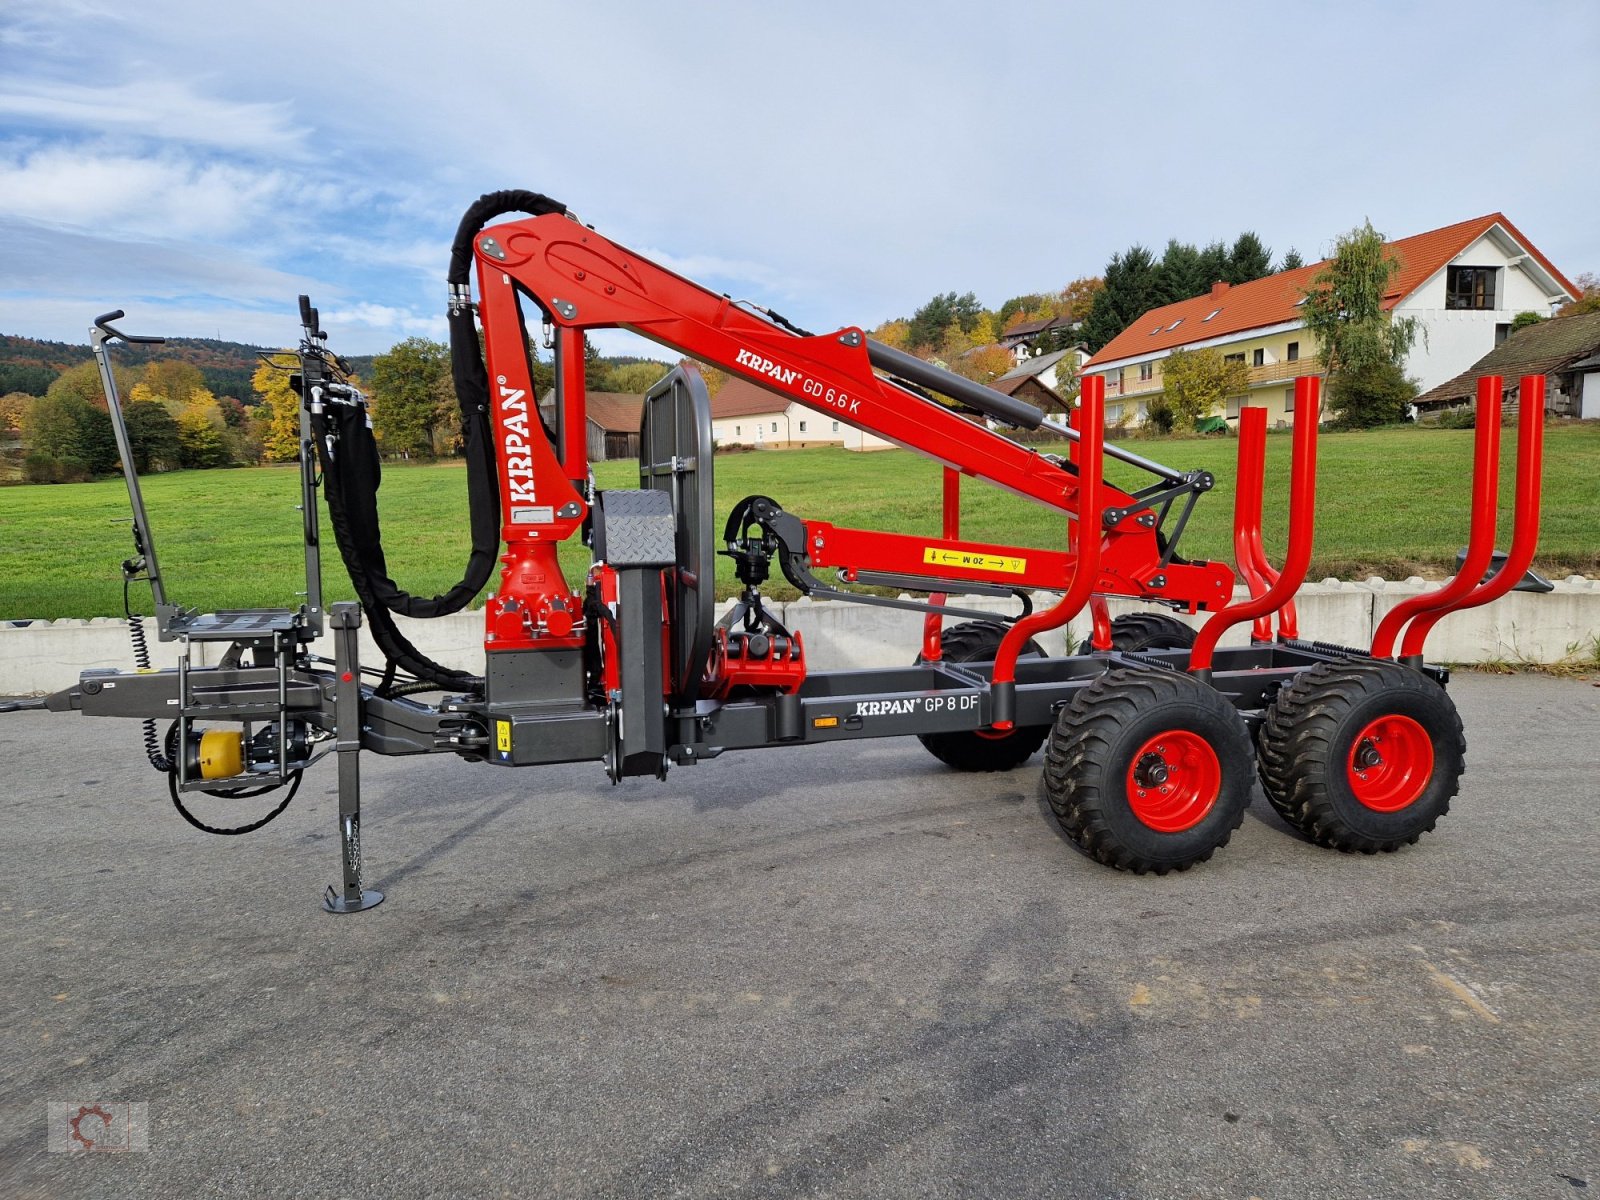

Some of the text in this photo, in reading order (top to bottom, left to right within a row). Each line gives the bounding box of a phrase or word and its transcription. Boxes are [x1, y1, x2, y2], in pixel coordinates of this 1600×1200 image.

[735, 348, 862, 415] KRPAN GD 6,6 K
[962, 556, 984, 566] 20 M
[855, 694, 979, 717] KRPAN GP 8 DF
